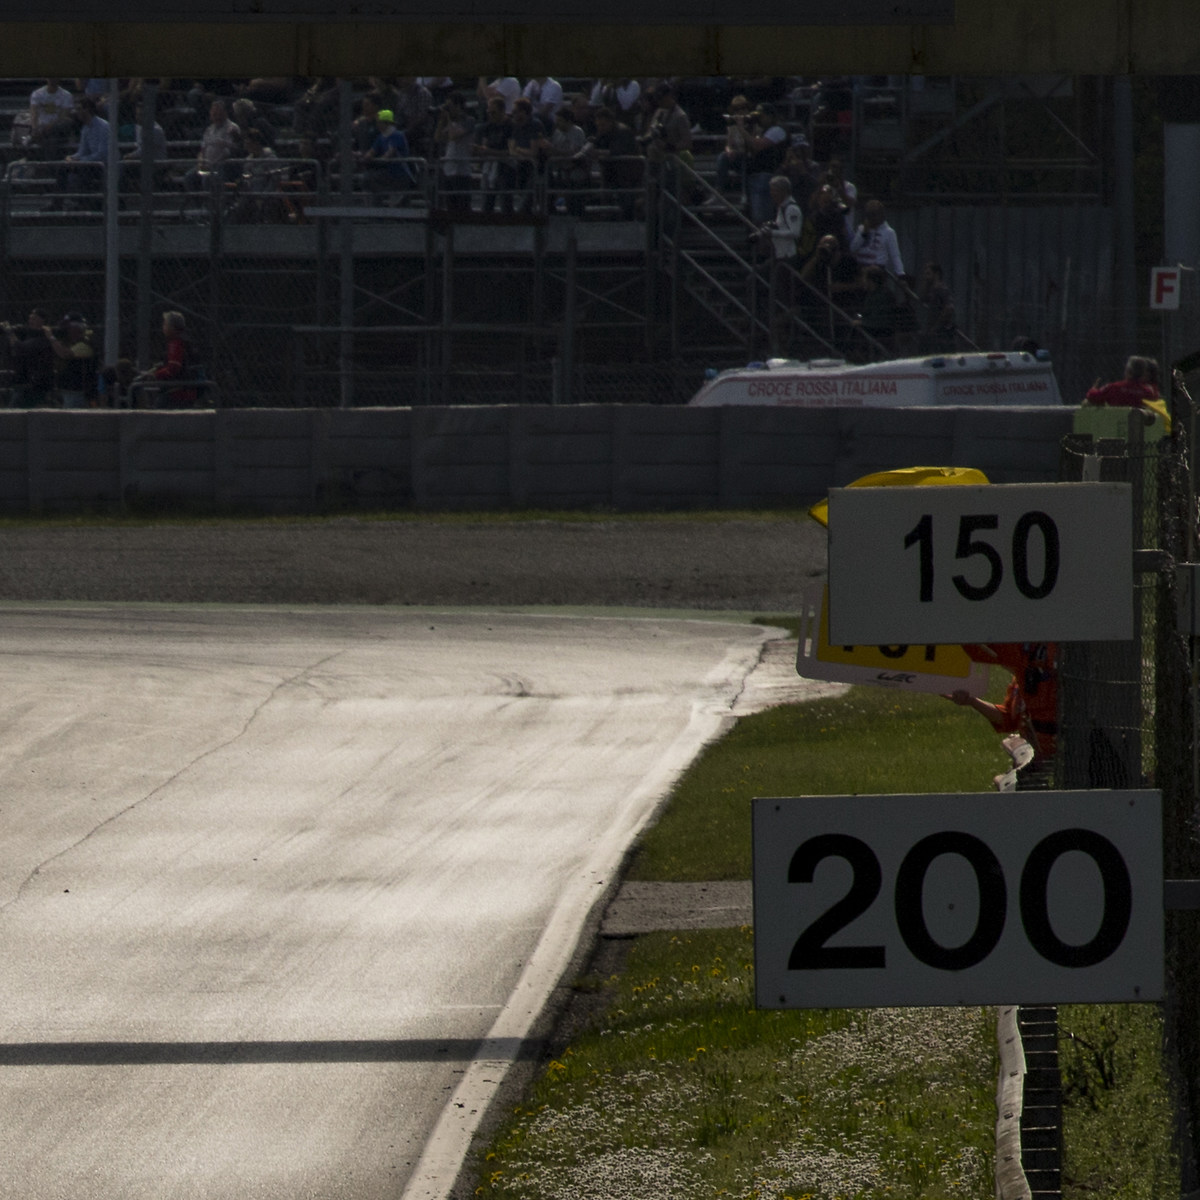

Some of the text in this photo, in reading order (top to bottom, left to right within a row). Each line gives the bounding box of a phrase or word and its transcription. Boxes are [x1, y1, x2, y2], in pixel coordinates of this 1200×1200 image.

[1156, 272, 1177, 303] F
[747, 381, 898, 396] CROCE ROSSA ITALIANA
[904, 511, 1060, 602] 150
[788, 828, 1132, 971] 200
